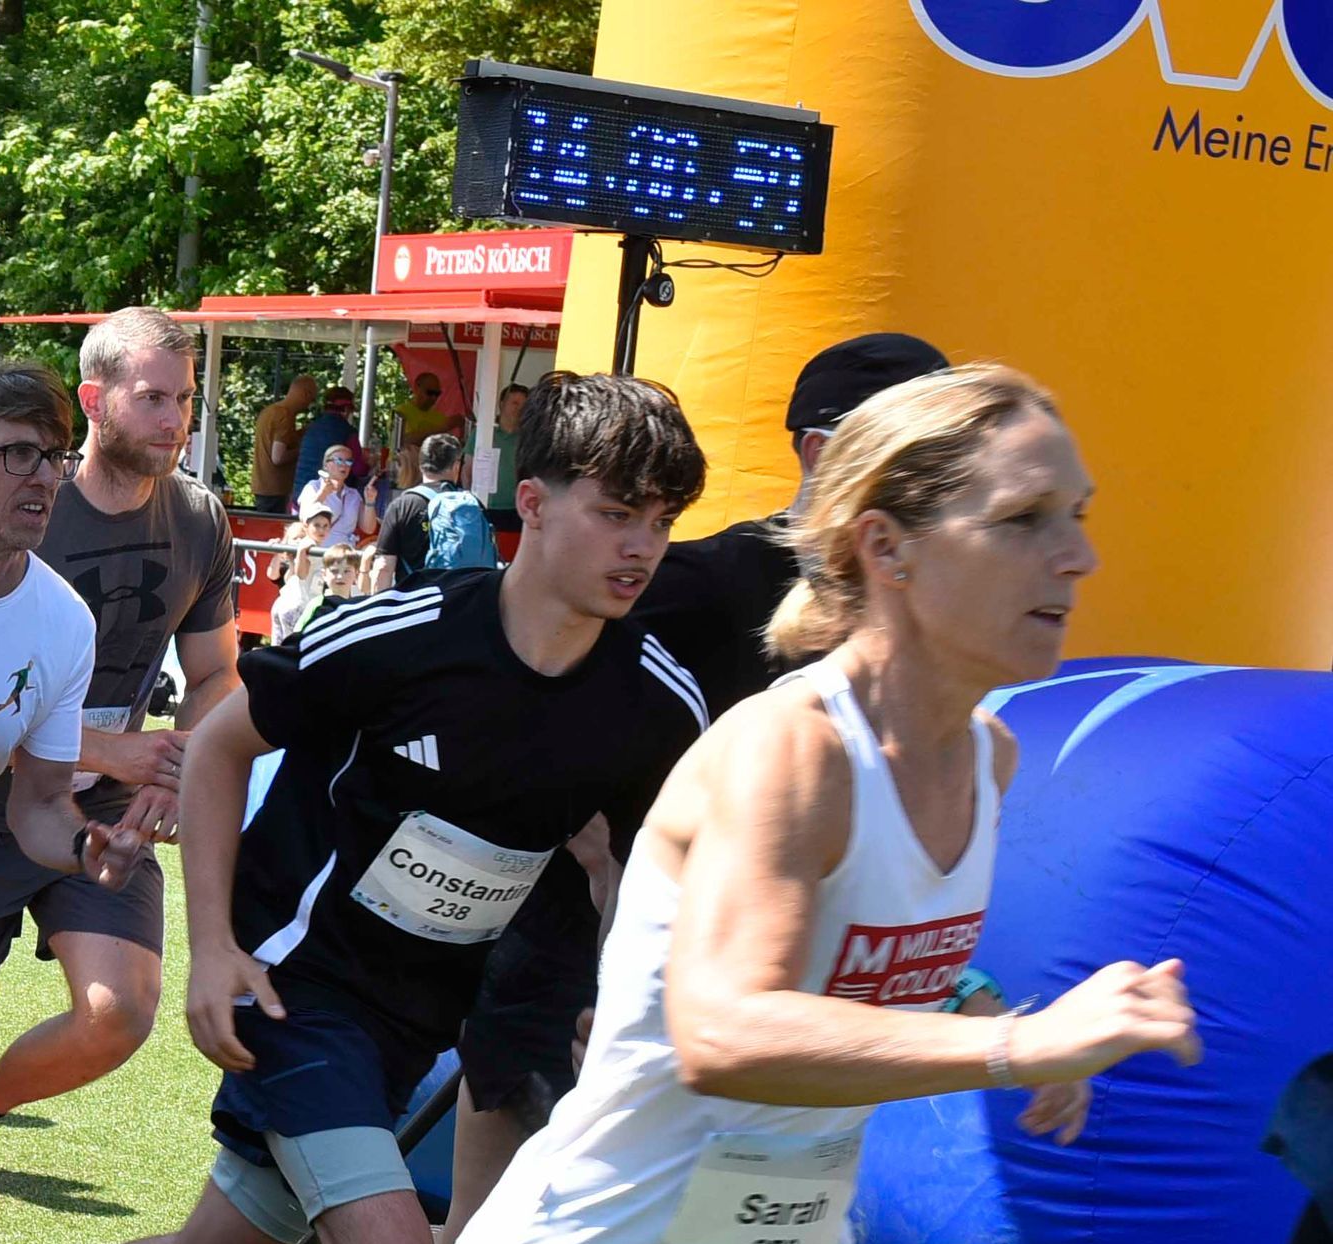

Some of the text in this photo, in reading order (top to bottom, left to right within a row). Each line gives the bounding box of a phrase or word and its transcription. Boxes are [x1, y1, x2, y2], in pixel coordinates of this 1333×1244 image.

[1152, 105, 1292, 166] Meine
[425, 245, 485, 276] PETERS
[389, 848, 530, 902] Constantin
[426, 898, 471, 921] 238
[735, 1191, 831, 1226] Sarah
